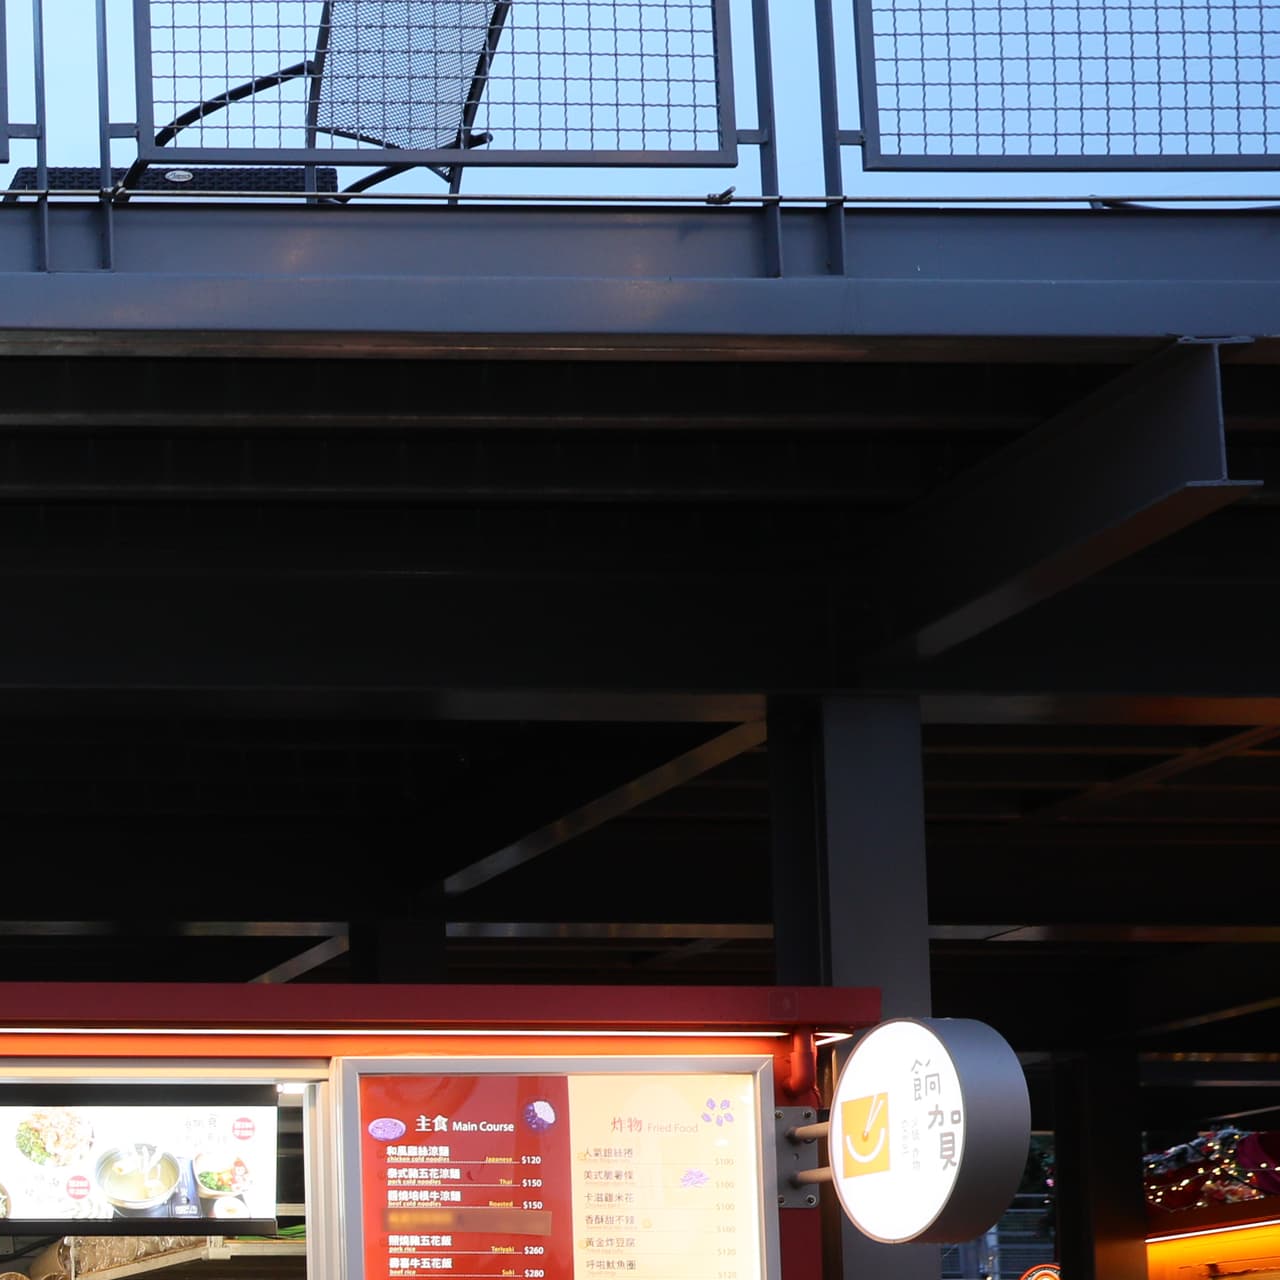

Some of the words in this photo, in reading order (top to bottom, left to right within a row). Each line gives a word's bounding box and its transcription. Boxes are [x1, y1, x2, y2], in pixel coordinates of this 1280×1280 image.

[416, 1115, 449, 1132] 主食
[452, 1122, 478, 1132] Main
[479, 1121, 514, 1132] Course
[611, 1117, 643, 1133] 炸物
[522, 1156, 541, 1164] $120
[522, 1179, 542, 1187] $150
[523, 1201, 543, 1210] $150
[524, 1246, 544, 1255] $260
[524, 1269, 544, 1278] $280
